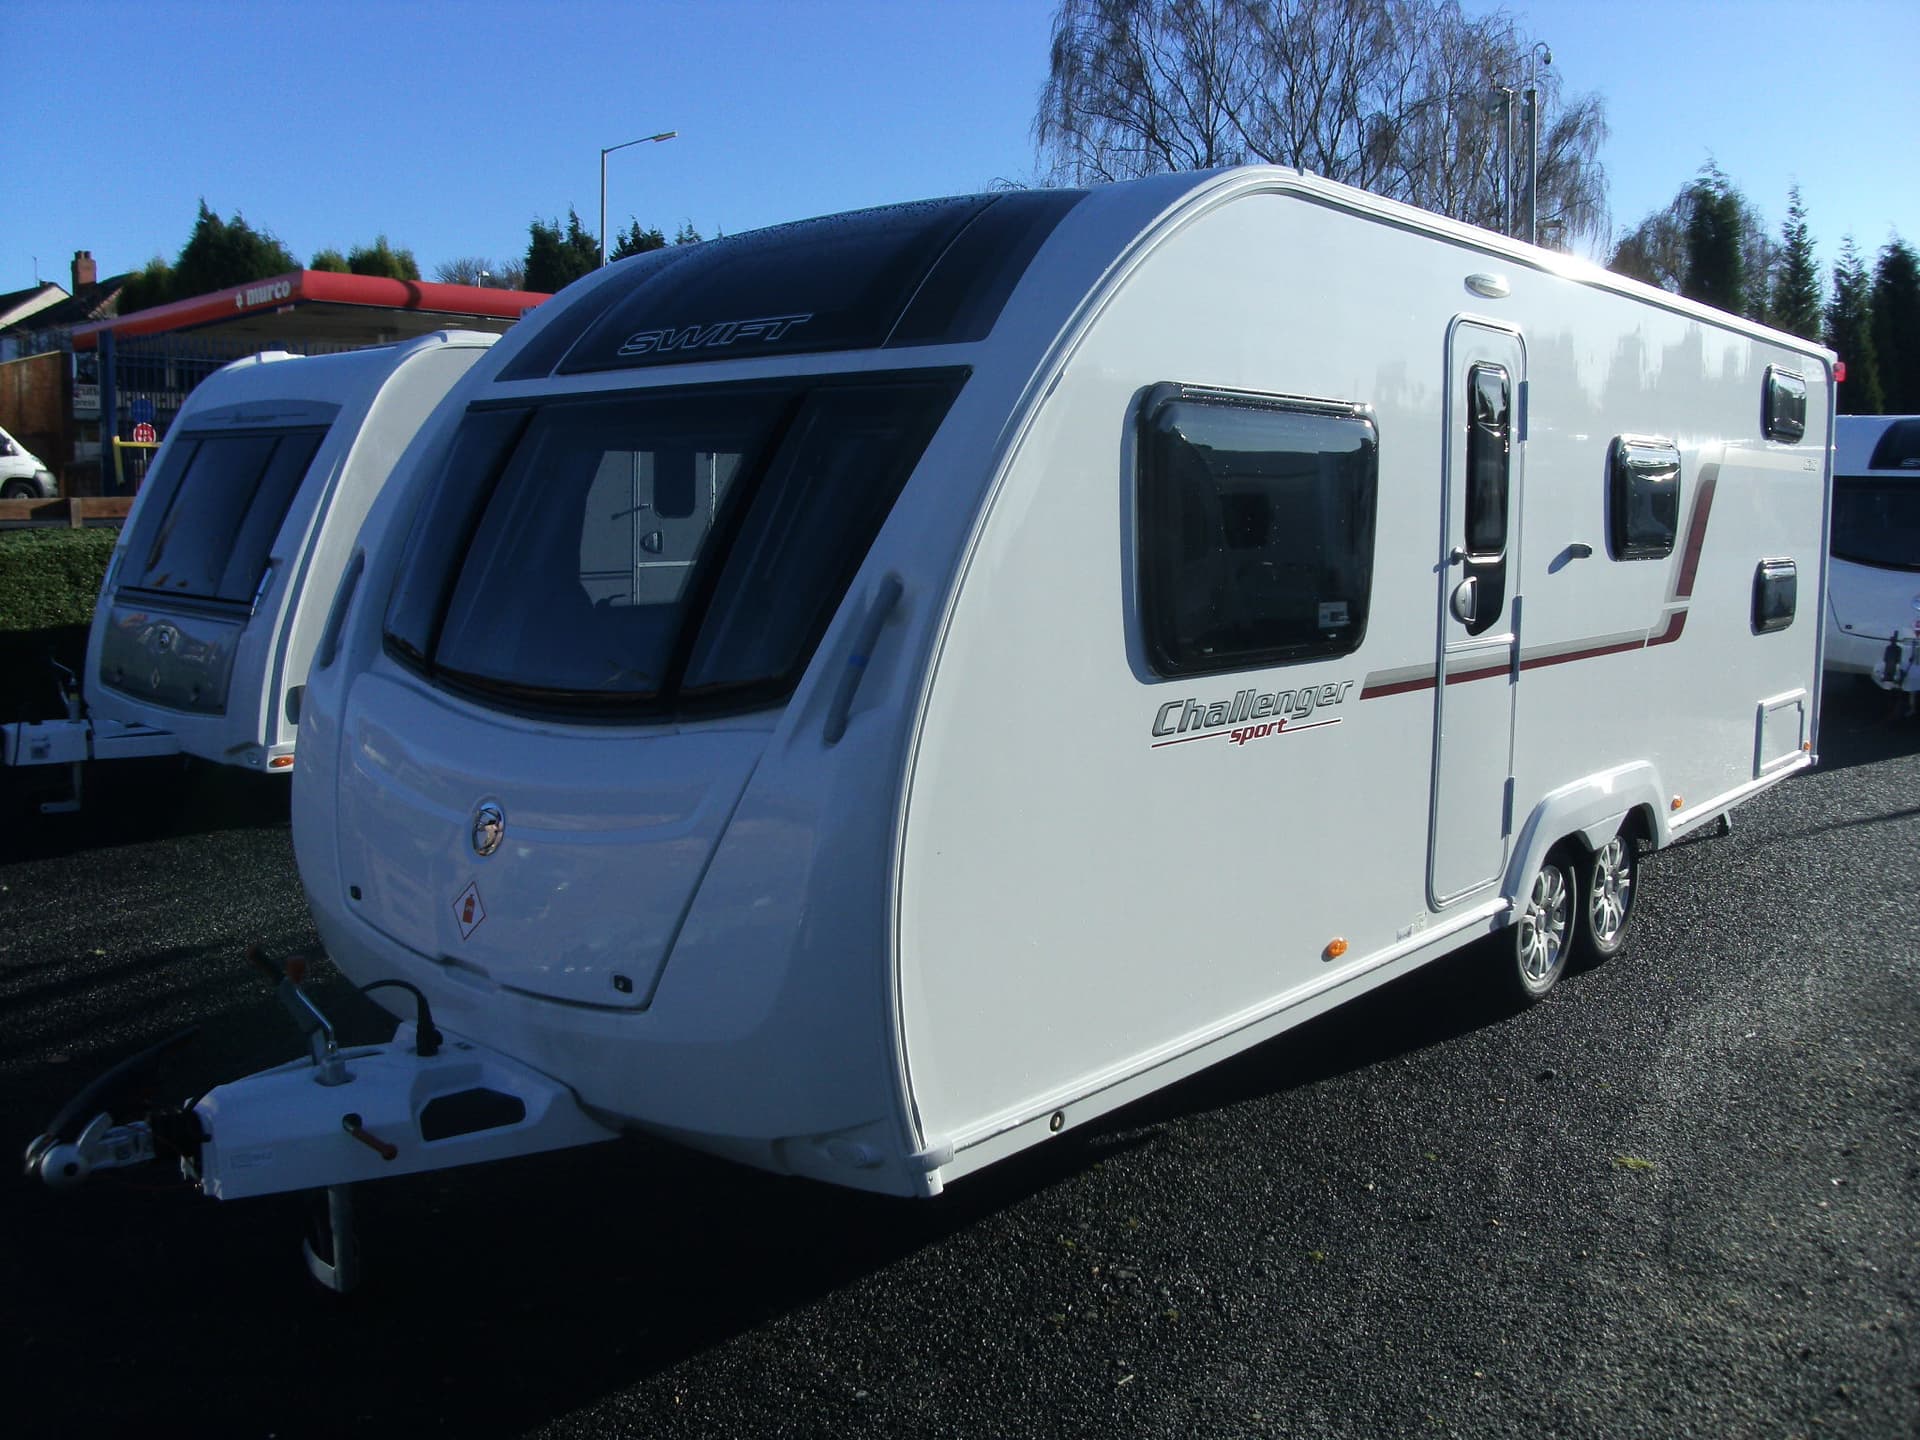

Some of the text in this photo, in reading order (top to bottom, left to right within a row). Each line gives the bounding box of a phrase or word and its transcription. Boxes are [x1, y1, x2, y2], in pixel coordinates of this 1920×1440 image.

[246, 281, 291, 306] murco
[617, 313, 813, 356] SWIFT
[1151, 680, 1354, 738] Challenger
[1229, 718, 1288, 745] sport
